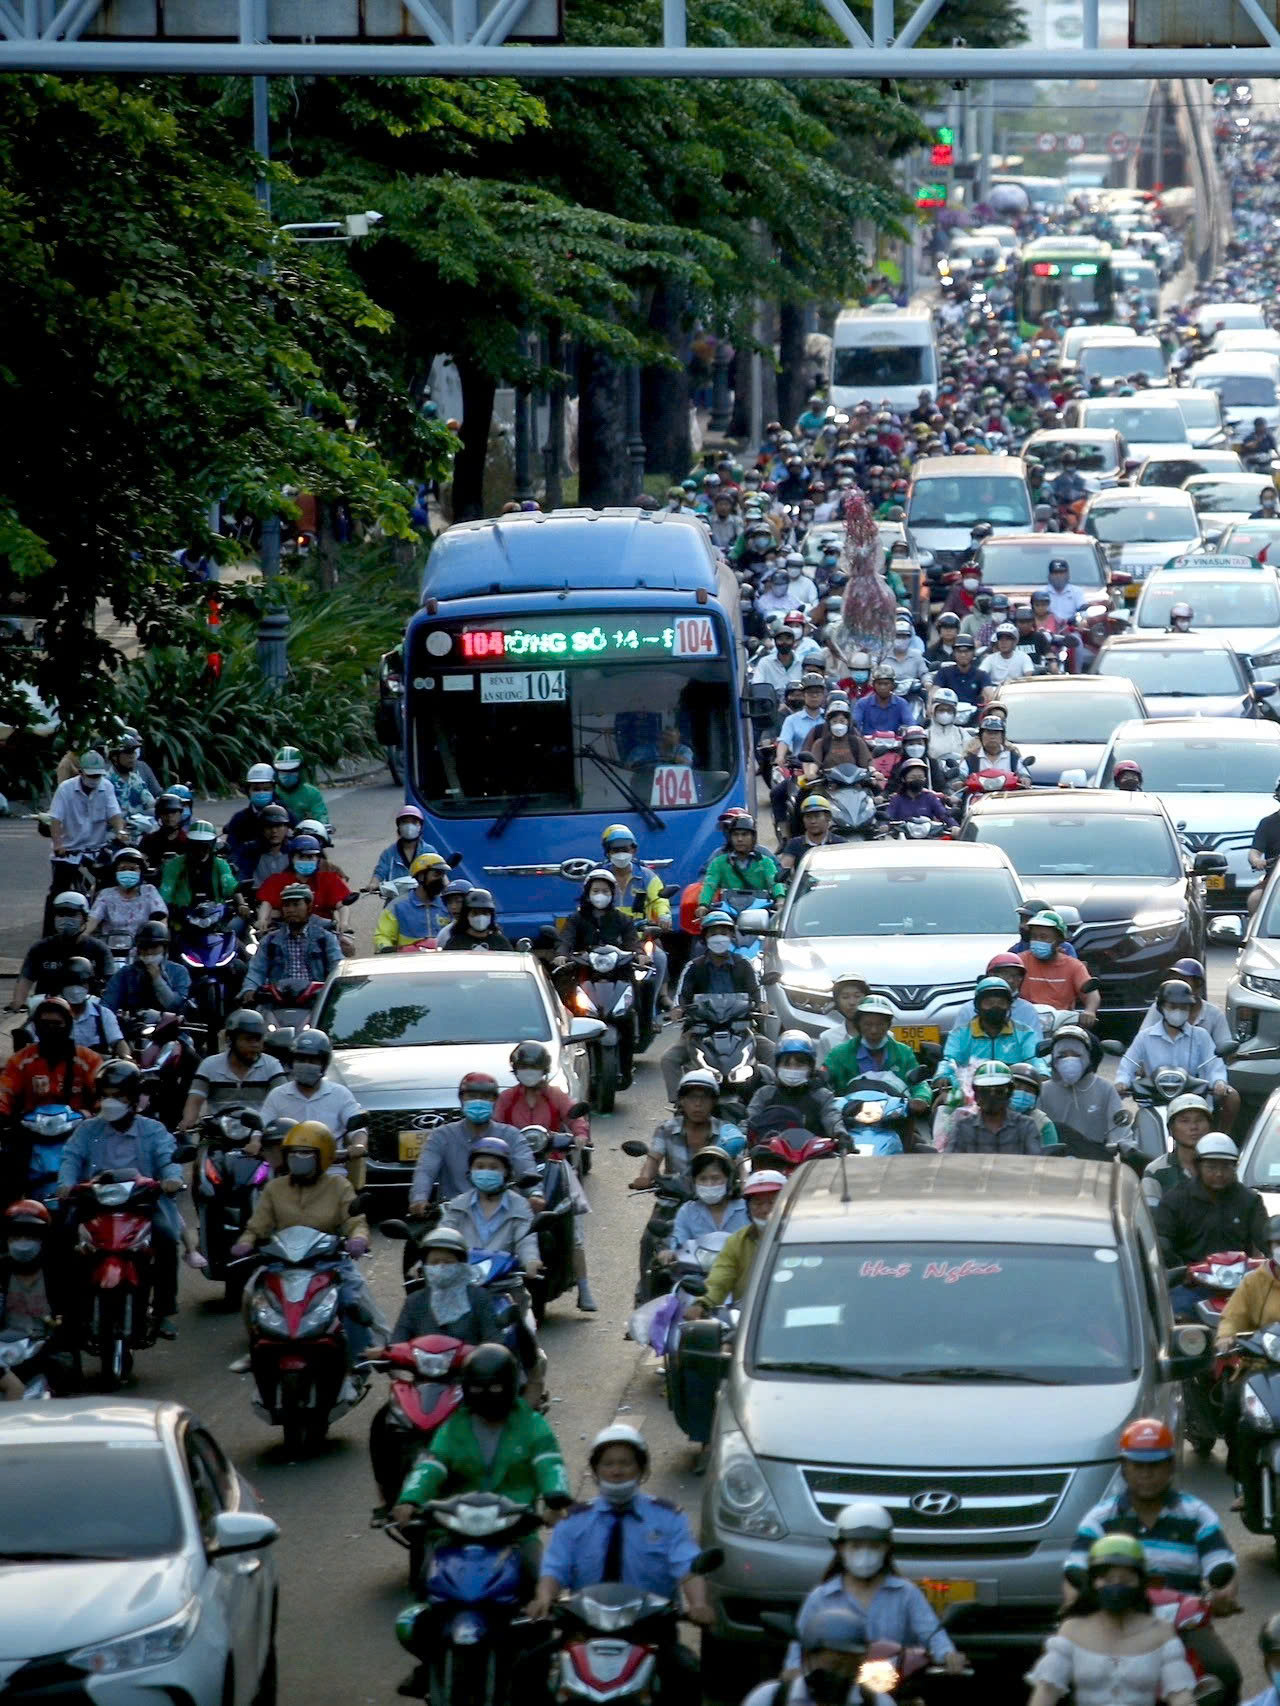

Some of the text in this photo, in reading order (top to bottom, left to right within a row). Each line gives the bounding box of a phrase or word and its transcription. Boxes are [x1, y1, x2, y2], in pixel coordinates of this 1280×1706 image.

[676, 619, 712, 653] 104
[525, 671, 564, 700] 104
[655, 768, 692, 805] 104
